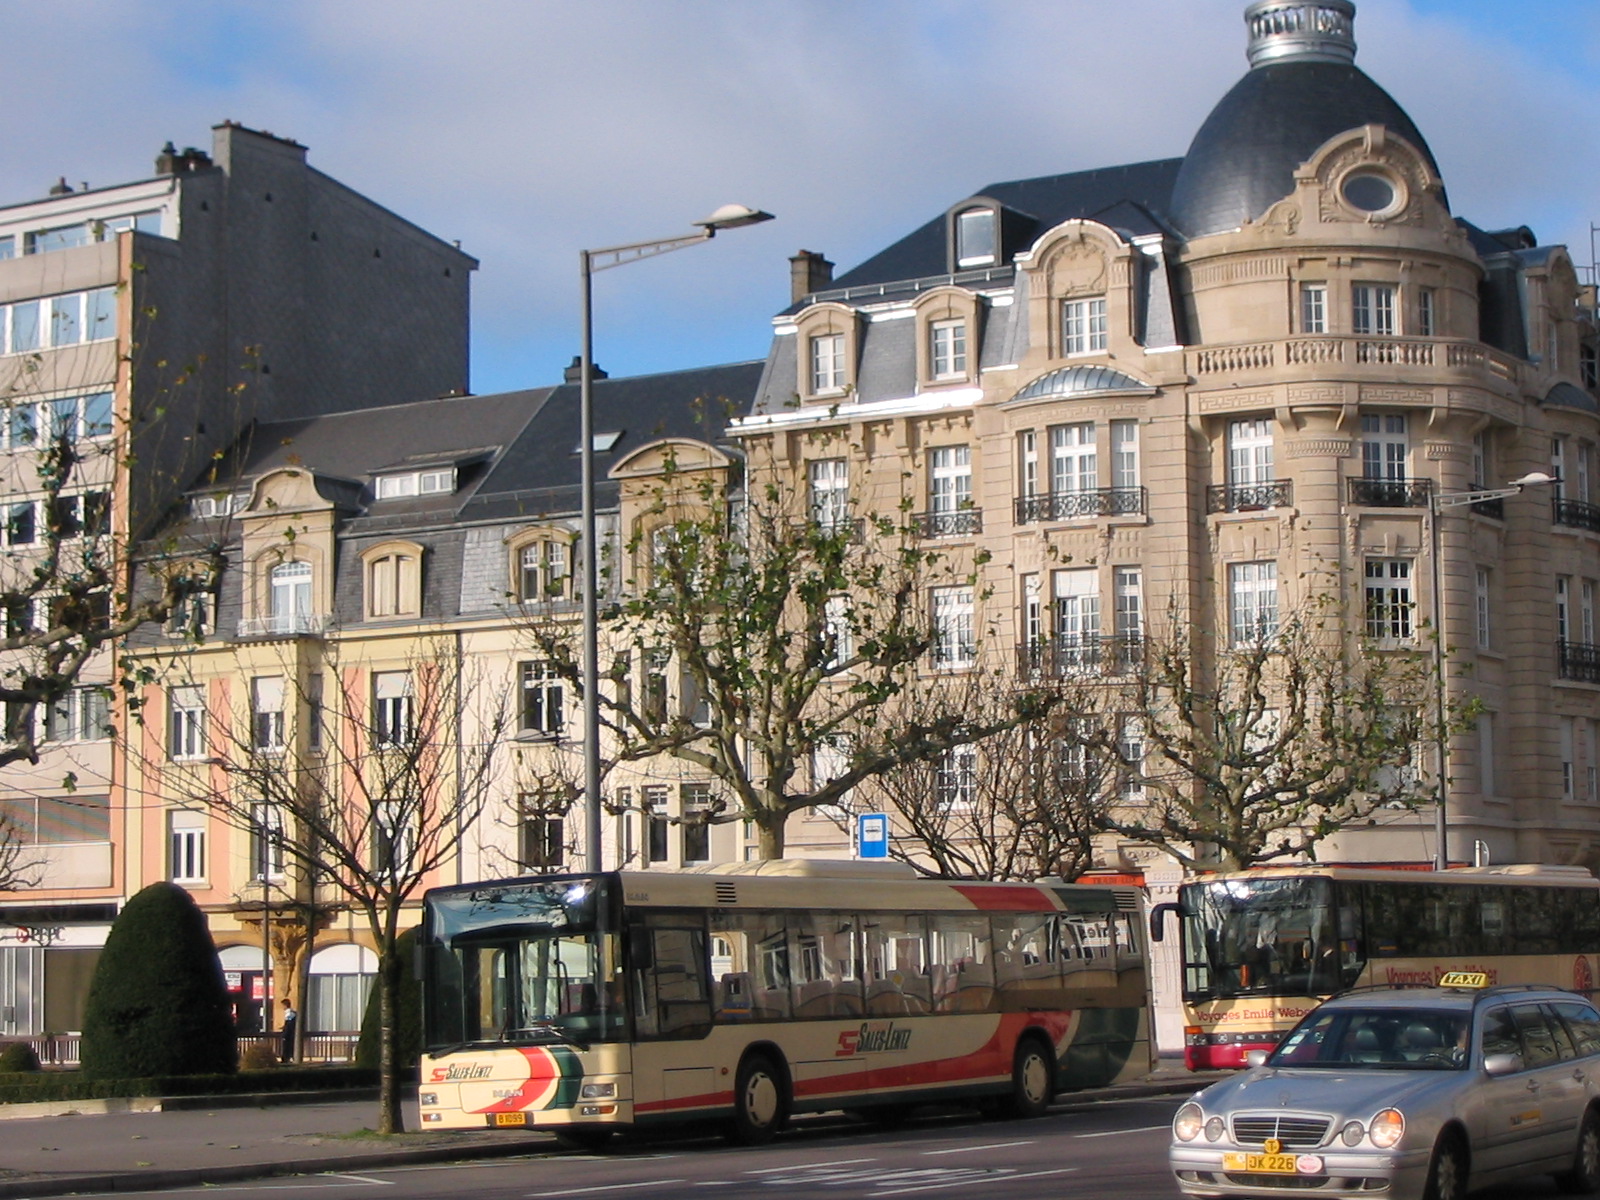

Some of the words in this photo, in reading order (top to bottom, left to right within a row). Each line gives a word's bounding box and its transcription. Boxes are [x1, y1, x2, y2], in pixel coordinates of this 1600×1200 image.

[1448, 973, 1481, 985] TAXI
[1196, 1011, 1240, 1023] Voyages
[1243, 1009, 1275, 1020] Emile
[1278, 1007, 1312, 1018] Webe
[1268, 1157, 1294, 1170] 226
